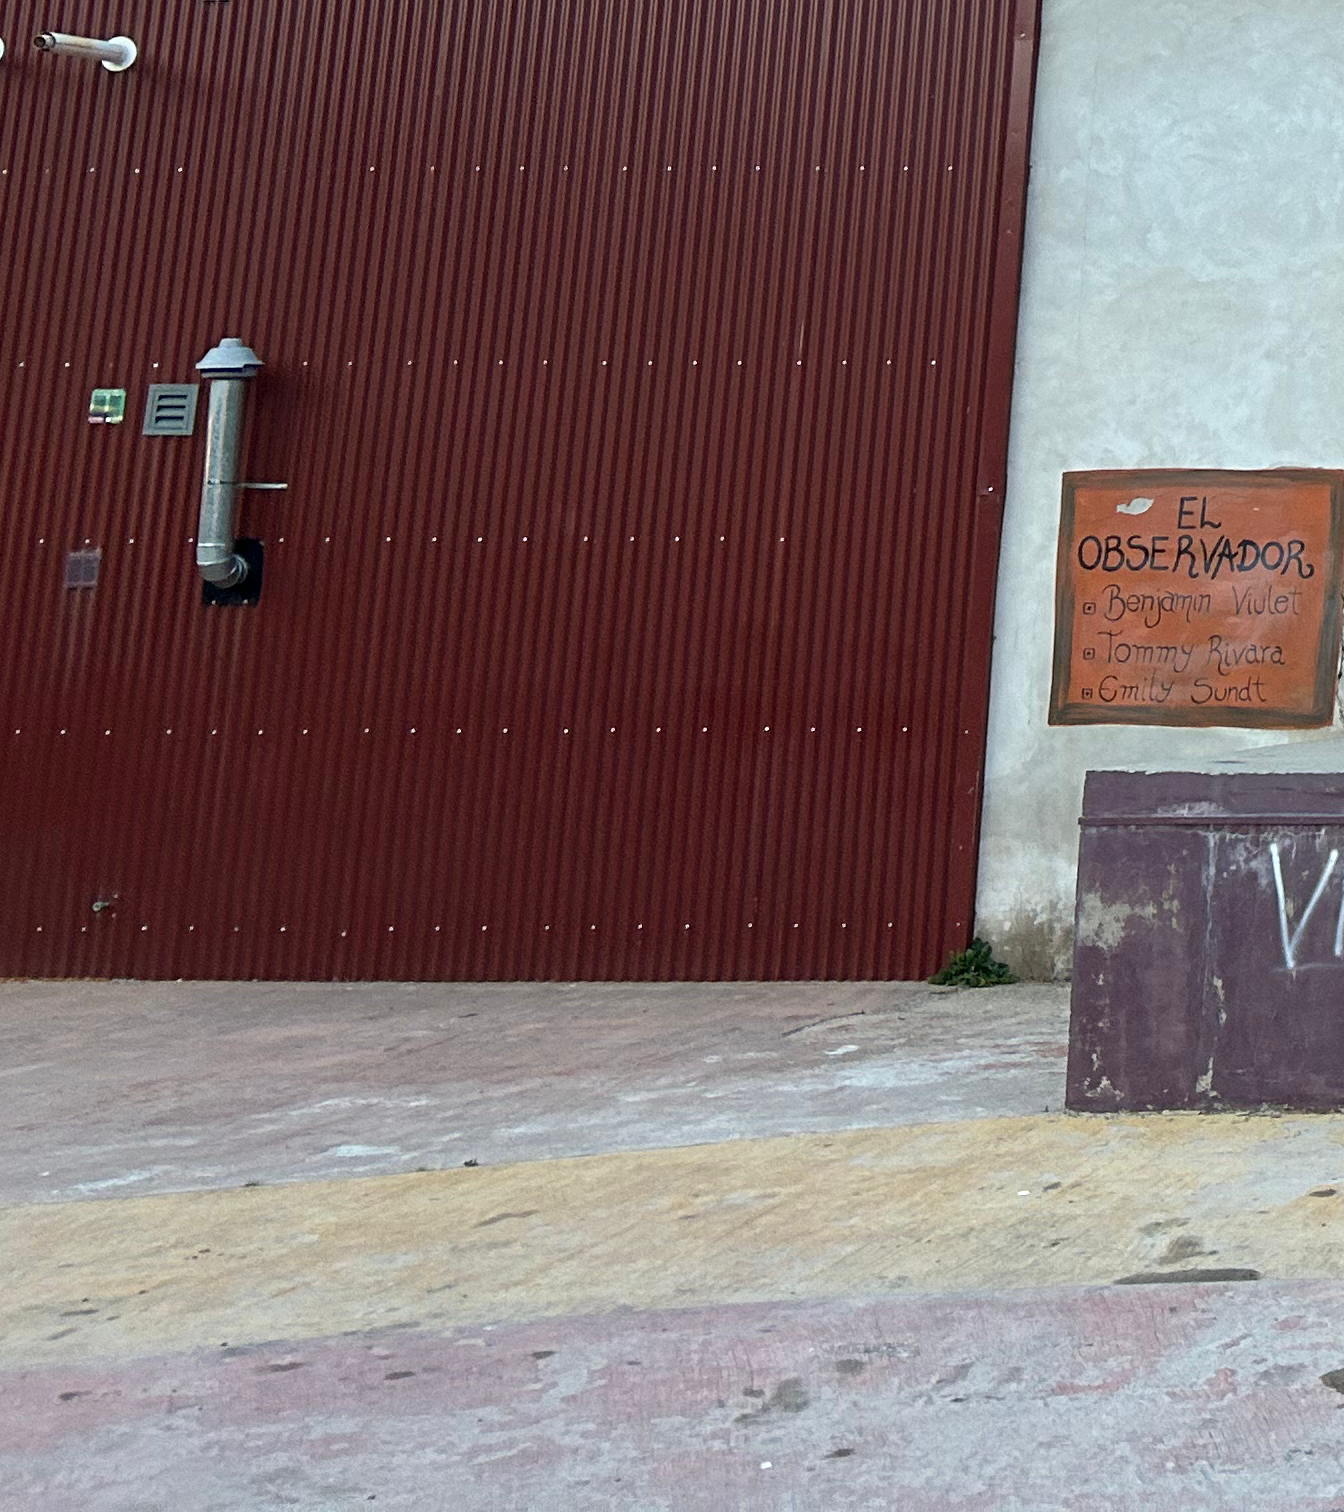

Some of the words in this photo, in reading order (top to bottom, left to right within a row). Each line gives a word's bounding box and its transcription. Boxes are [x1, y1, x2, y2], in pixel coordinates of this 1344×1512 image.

[1177, 496, 1222, 529] EL
[1077, 534, 1315, 580] OBSERVADOR
[1102, 583, 1211, 628] Benjamin
[1097, 629, 1194, 673] Tommy
[1206, 634, 1286, 676] Rivara
[1098, 669, 1174, 704] Emily
[1190, 676, 1267, 705] Sundt
